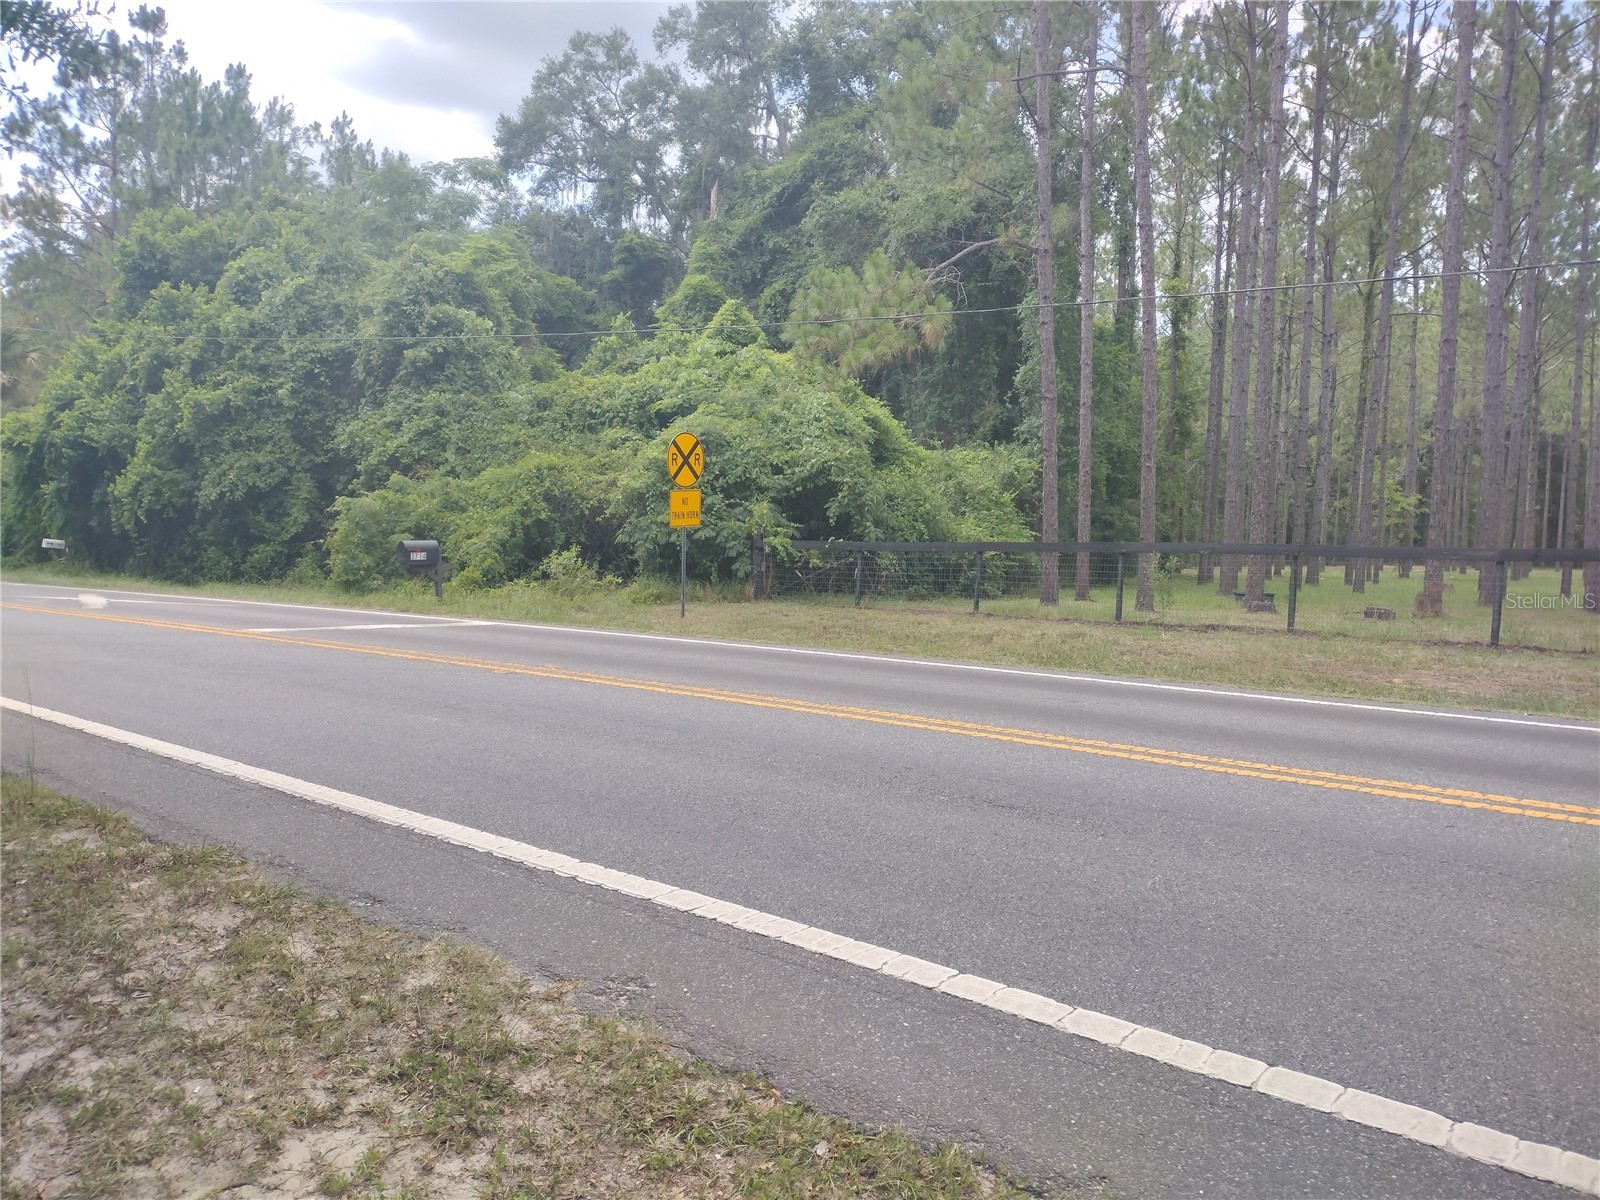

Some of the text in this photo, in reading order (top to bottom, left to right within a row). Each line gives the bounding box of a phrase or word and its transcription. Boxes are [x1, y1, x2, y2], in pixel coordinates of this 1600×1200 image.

[672, 453, 701, 466] R R
[682, 497, 688, 506] NO
[672, 510, 699, 520] TRAIN HORN
